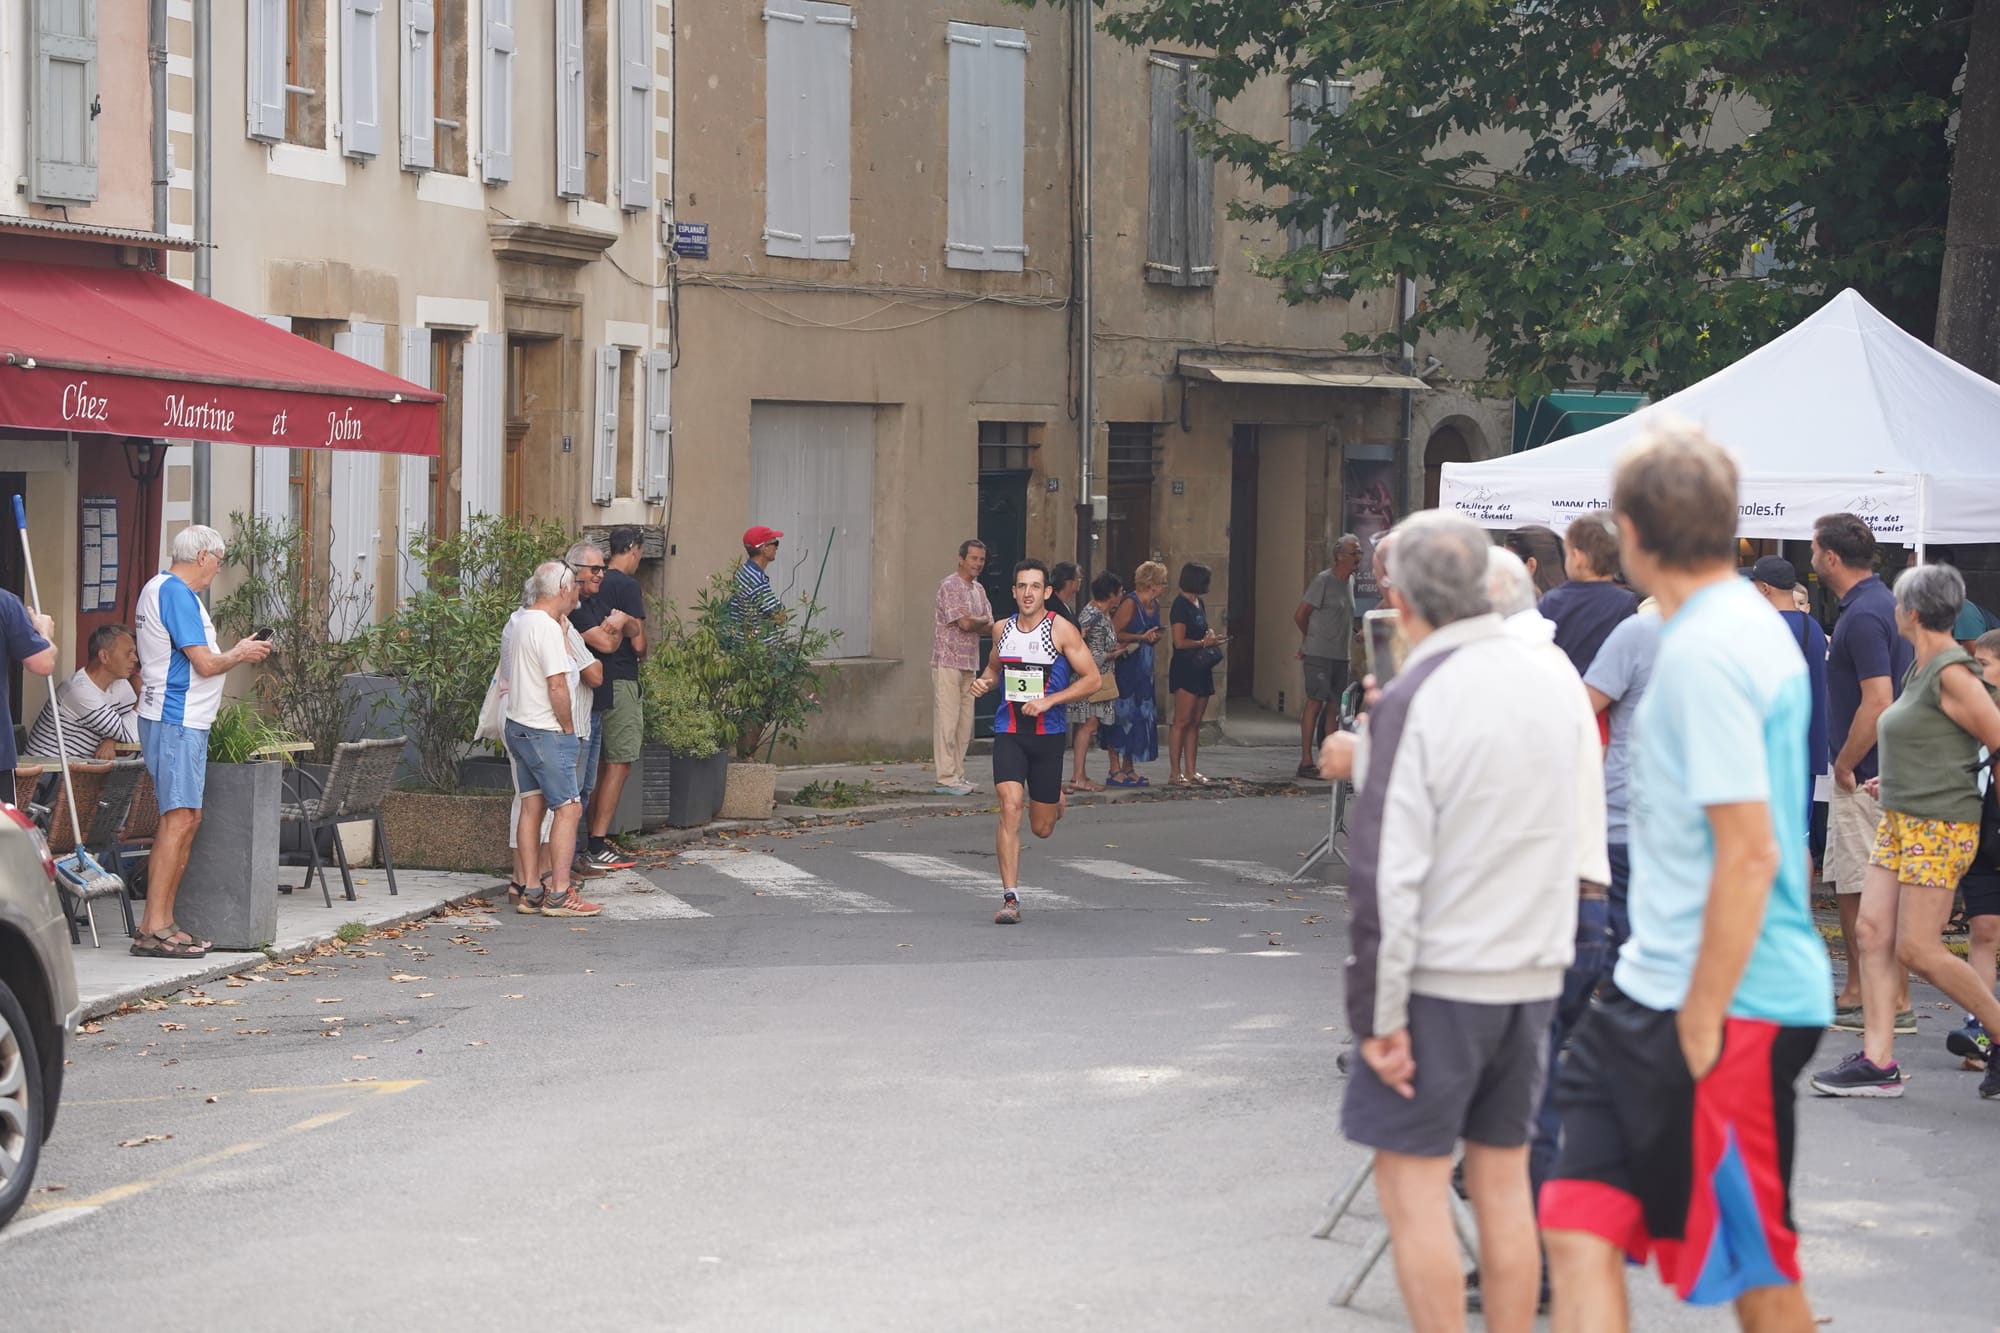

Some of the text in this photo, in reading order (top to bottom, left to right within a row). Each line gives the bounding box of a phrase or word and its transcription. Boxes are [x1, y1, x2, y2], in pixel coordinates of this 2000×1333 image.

[678, 225, 705, 234] ESPLANADE
[62, 381, 363, 446] Chez Martine et John
[1455, 501, 1511, 512] Challenge des
[1883, 515, 1900, 523] des
[1017, 679, 1028, 692] 3
